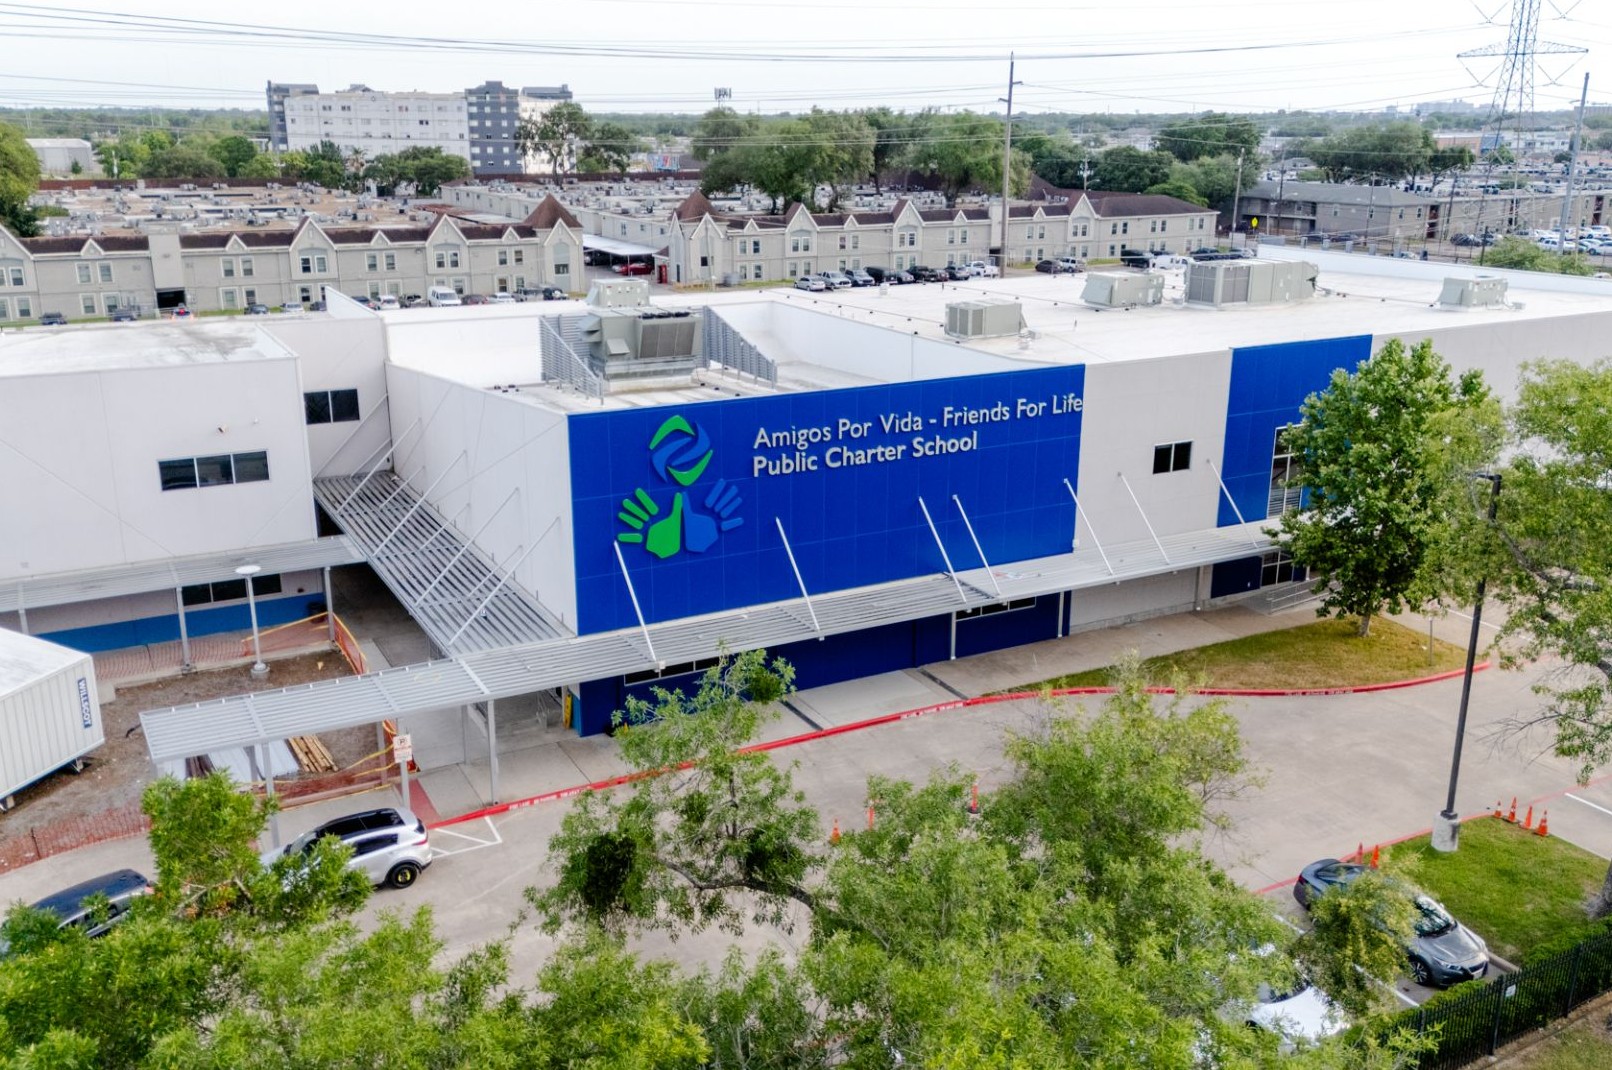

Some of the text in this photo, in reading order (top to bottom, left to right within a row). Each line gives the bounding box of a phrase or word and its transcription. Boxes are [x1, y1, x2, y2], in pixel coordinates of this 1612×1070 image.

[753, 425, 831, 450] Amigos
[838, 418, 872, 440] Por
[880, 411, 922, 434] Vida
[943, 401, 1009, 427] Friends
[1016, 398, 1047, 418] For
[1052, 393, 1083, 414] Life
[753, 430, 977, 477] Public Charter School
[79, 680, 91, 725] WILLSCOT
